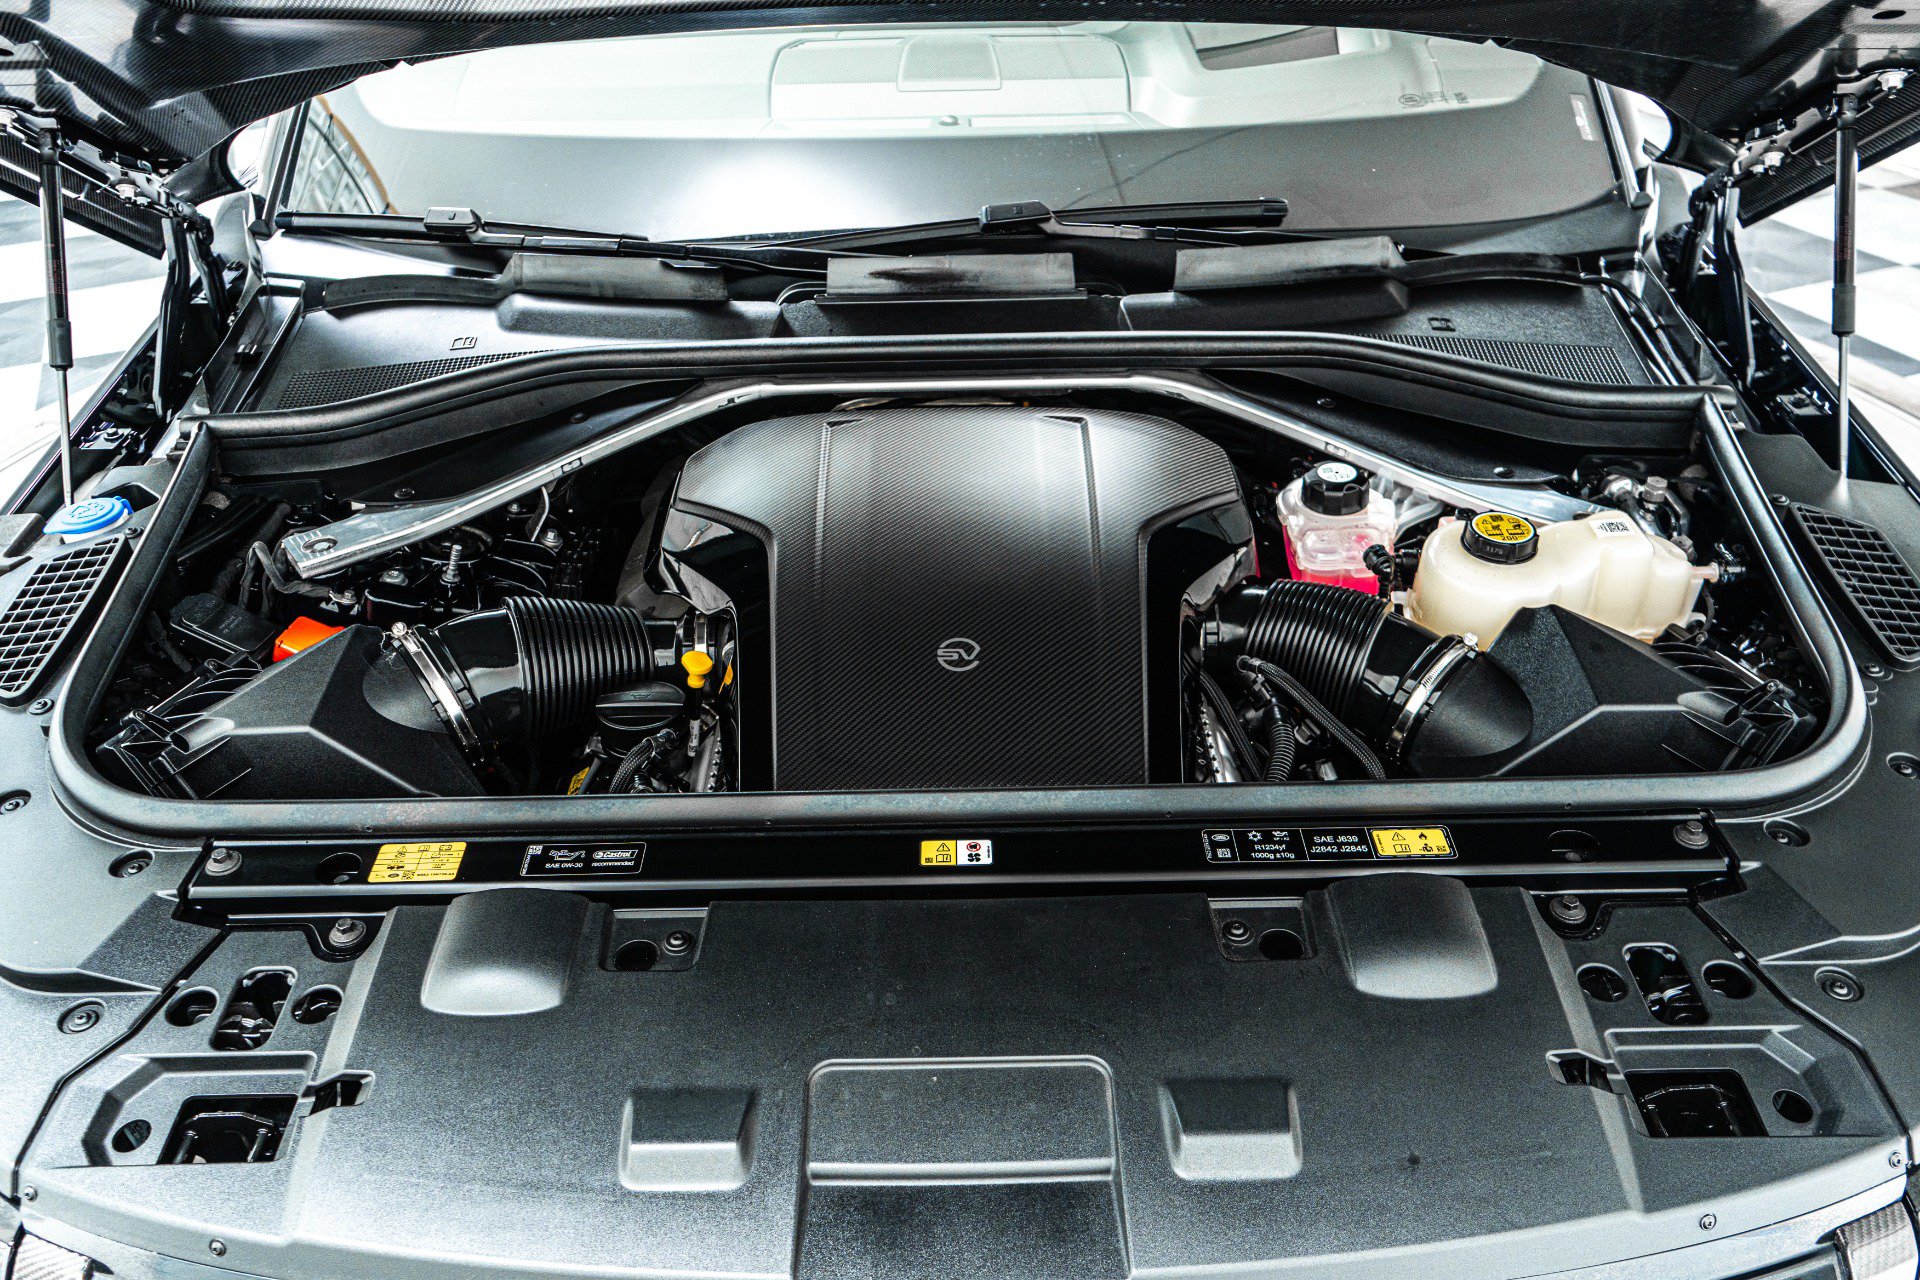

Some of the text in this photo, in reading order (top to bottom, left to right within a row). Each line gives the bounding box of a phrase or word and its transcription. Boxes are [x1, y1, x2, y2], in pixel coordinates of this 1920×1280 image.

[1313, 835, 1359, 843] SAE J639
[1340, 844, 1368, 852] J2845
